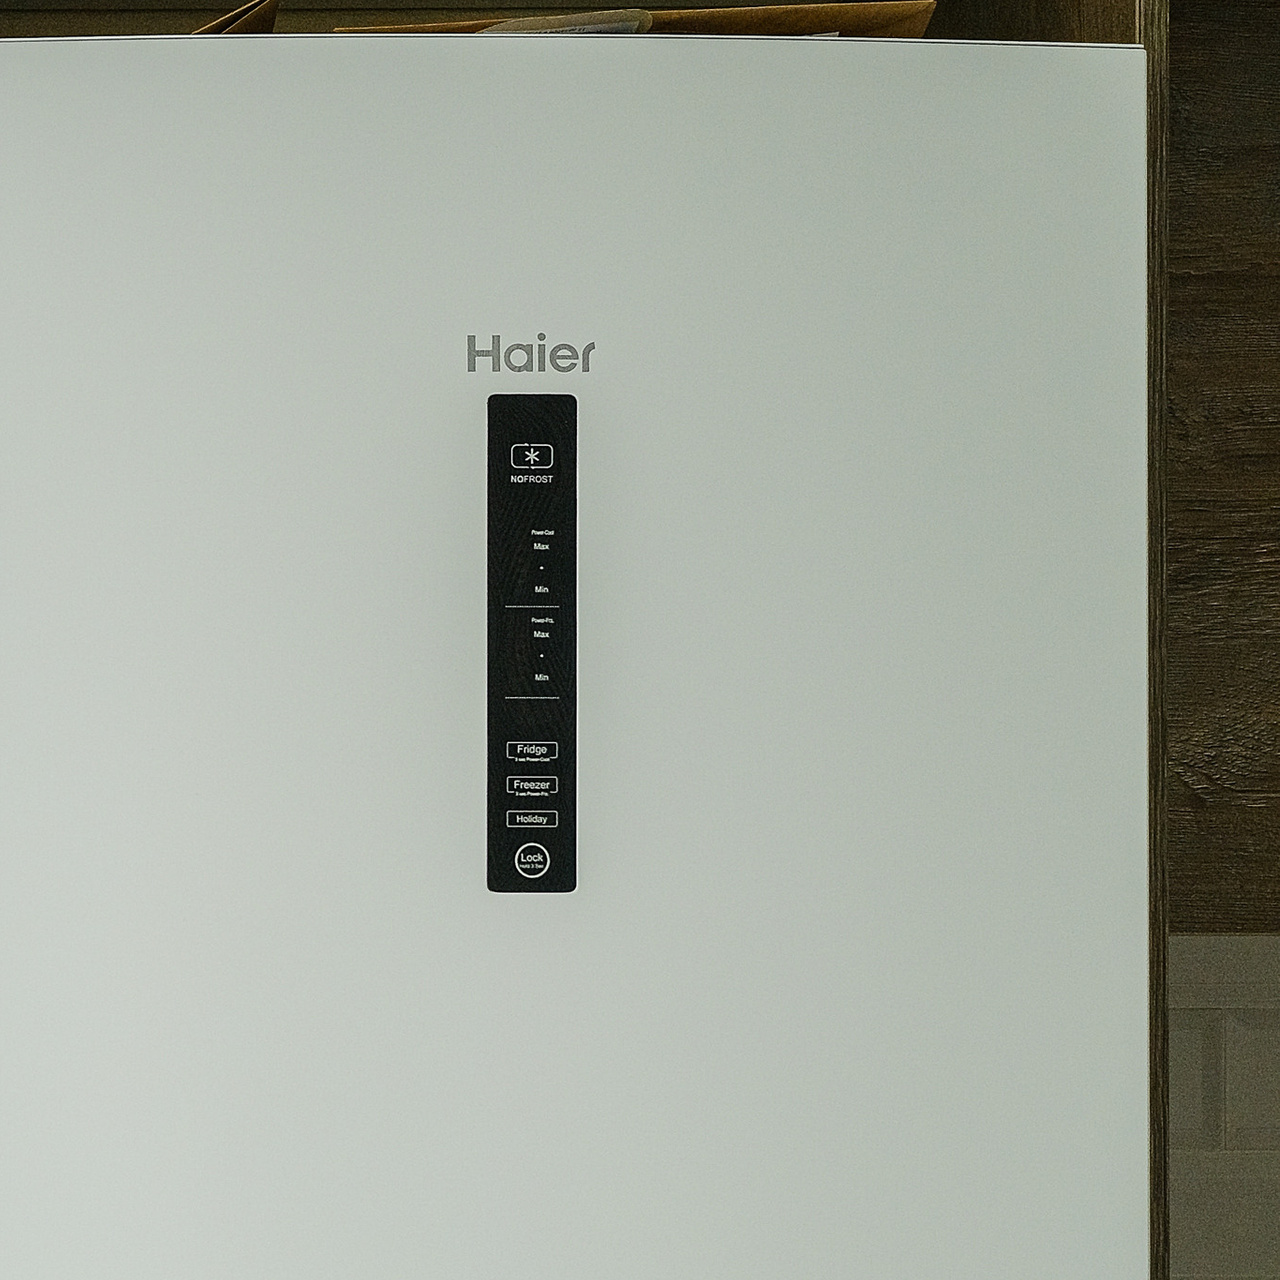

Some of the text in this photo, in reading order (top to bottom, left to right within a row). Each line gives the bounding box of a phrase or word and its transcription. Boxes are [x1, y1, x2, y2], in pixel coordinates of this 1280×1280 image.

[467, 332, 596, 373] Haier
[510, 475, 554, 484] NOFROST
[533, 542, 550, 550] Max
[534, 585, 550, 593] Min
[533, 630, 550, 638] Max
[534, 673, 550, 681] Min
[517, 744, 548, 756] Fridge
[513, 780, 550, 790] Freezer
[516, 814, 548, 825] Holiday
[520, 852, 544, 863] Lock
